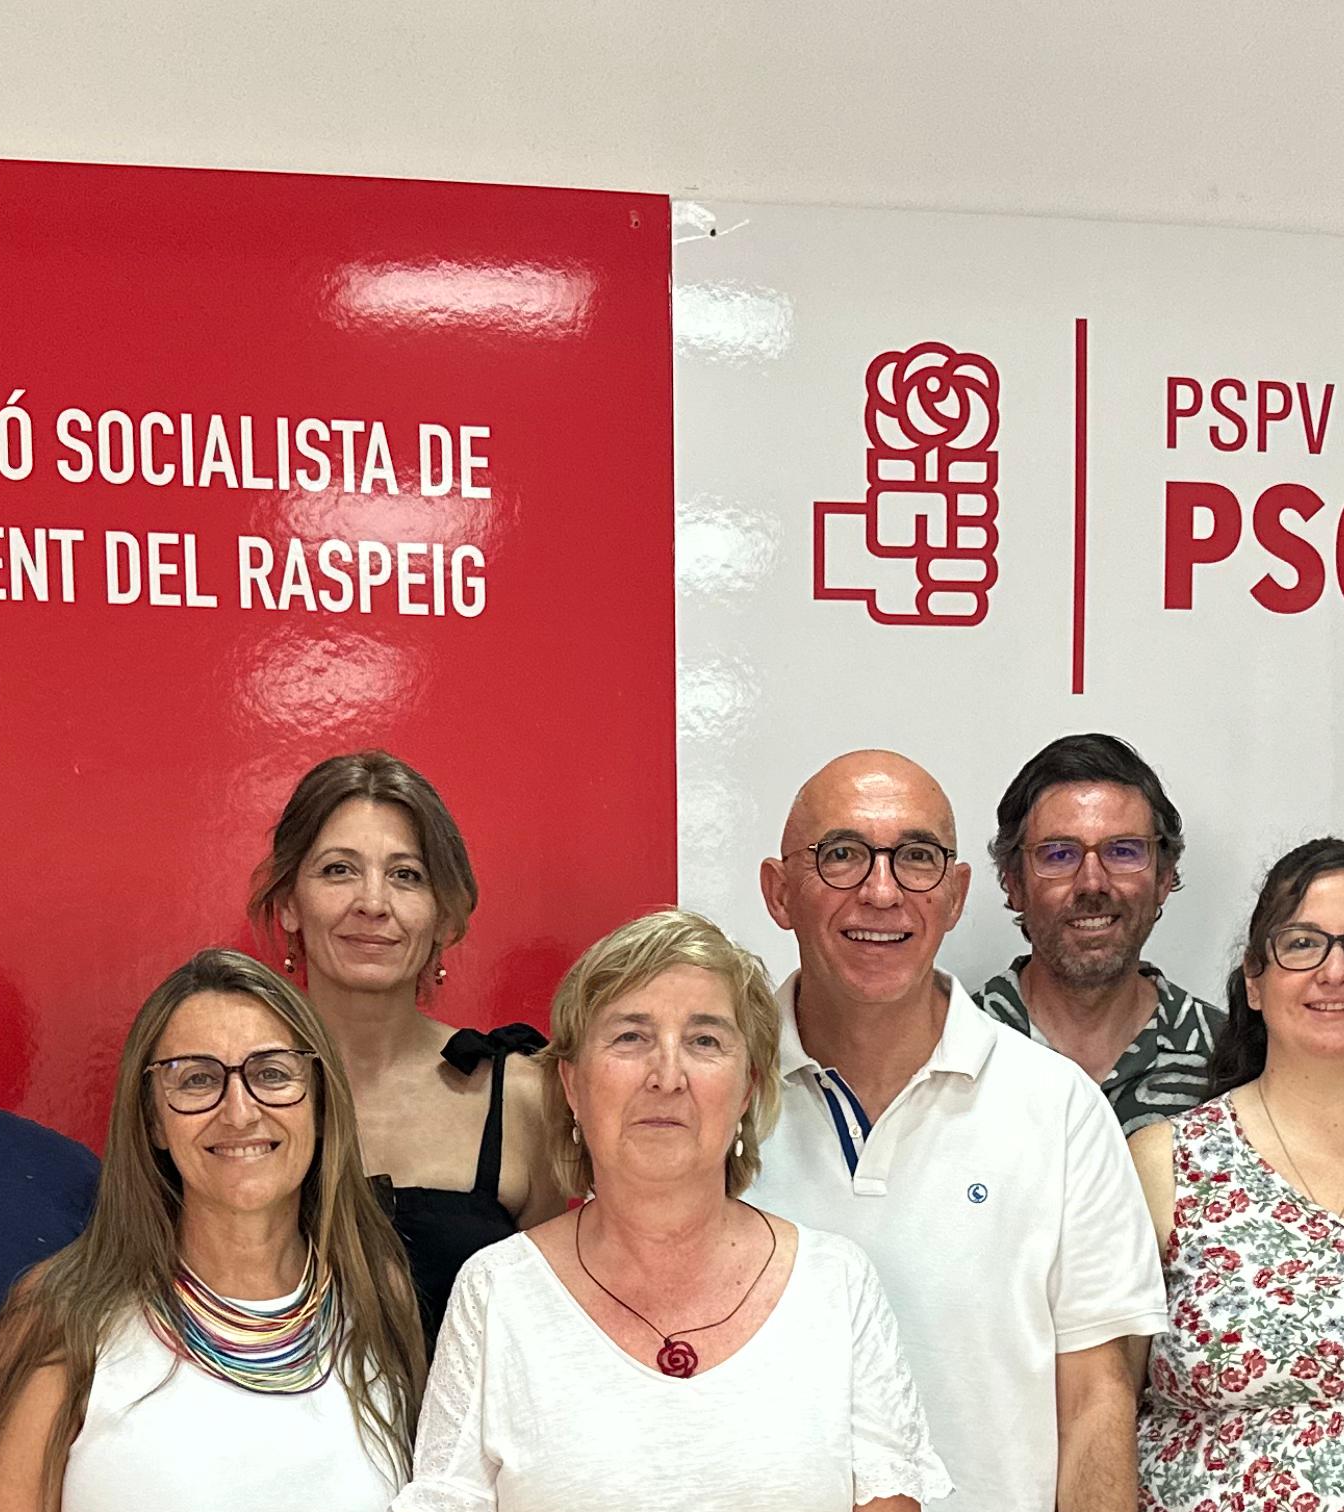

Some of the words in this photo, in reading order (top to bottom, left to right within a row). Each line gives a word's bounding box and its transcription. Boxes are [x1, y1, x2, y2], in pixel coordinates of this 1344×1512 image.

[56, 408, 403, 497] SOCIALISTA
[419, 424, 492, 500] DE
[1166, 376, 1336, 455] PSPV
[105, 530, 218, 608] DEL
[238, 536, 488, 618] RASPEIG
